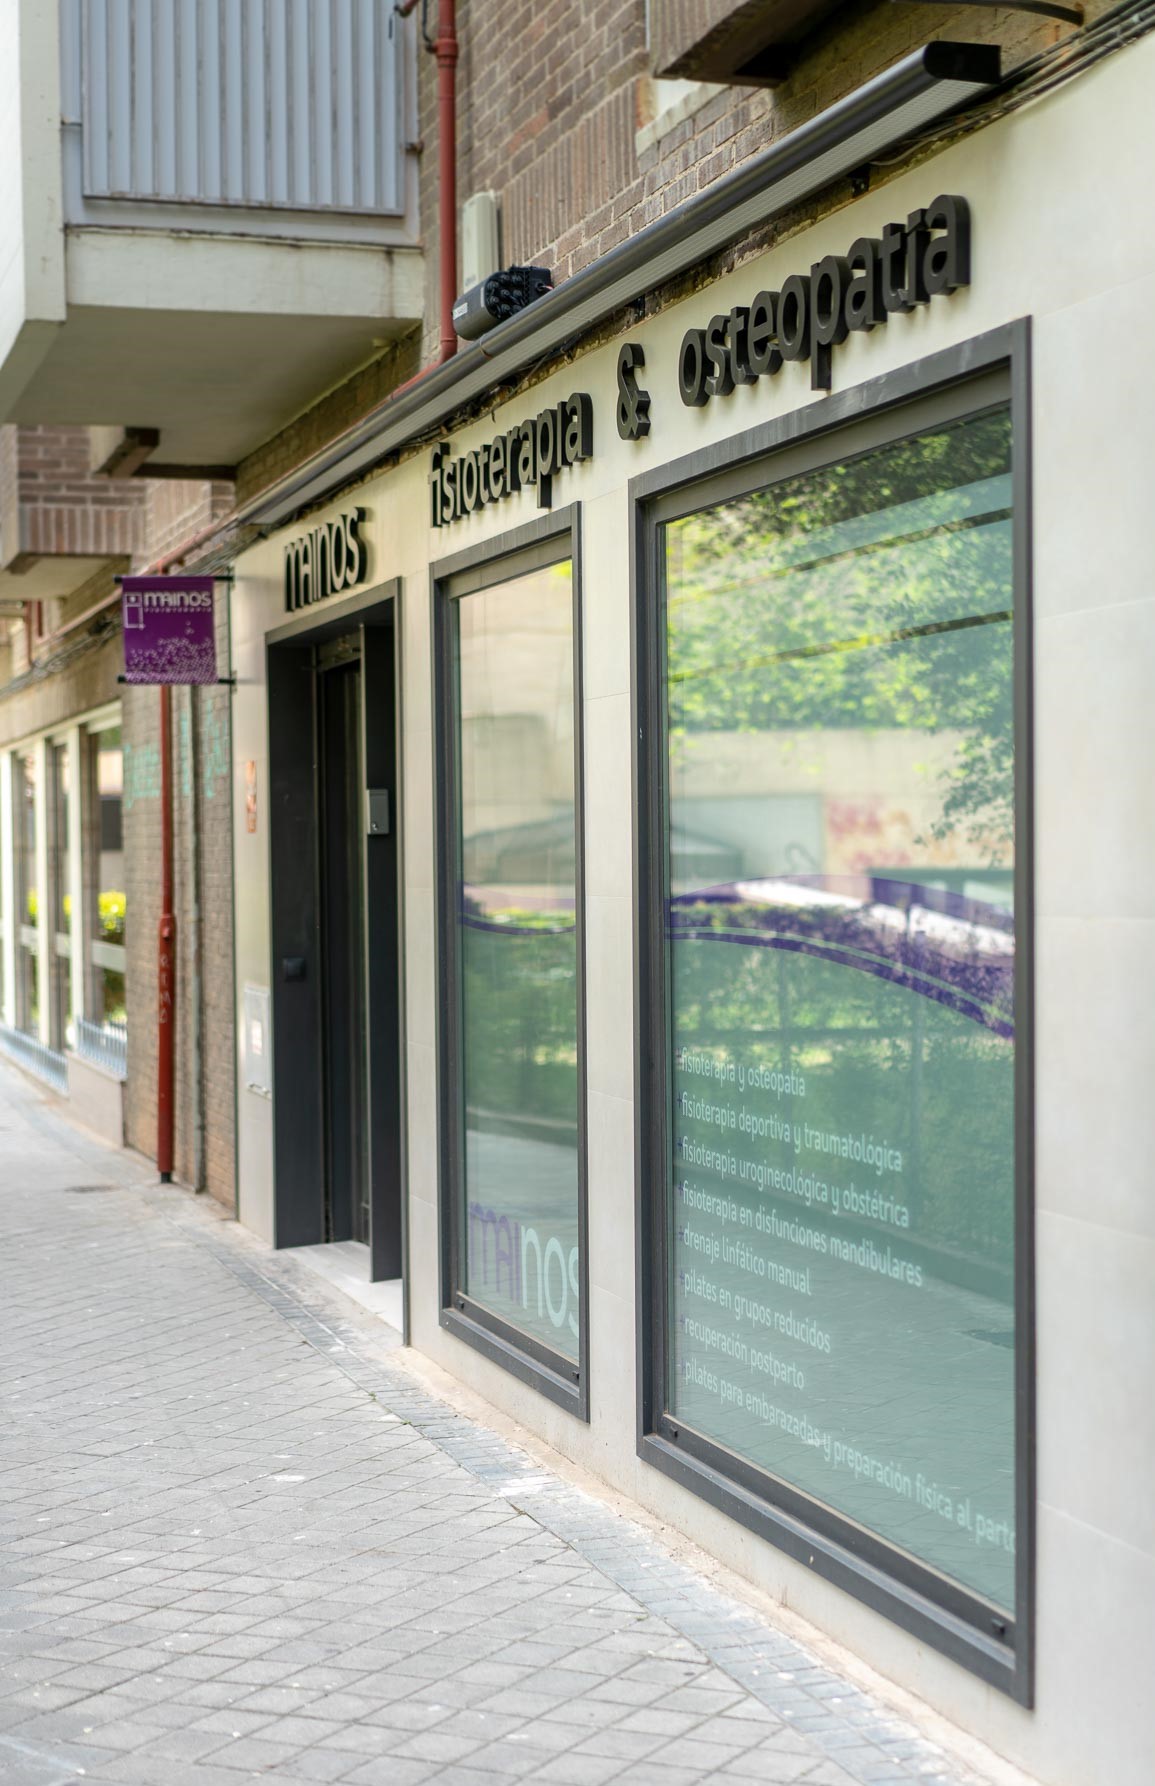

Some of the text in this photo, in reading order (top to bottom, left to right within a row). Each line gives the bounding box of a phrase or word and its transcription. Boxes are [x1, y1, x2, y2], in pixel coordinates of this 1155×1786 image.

[429, 392, 594, 529] fisioterapia
[616, 342, 652, 442] &
[681, 1047, 736, 1088] fisioterapia
[738, 1064, 745, 1092] y
[681, 1091, 903, 1176] fisioterapia deportiva y traumatológica
[682, 1135, 910, 1228] fisioterapia uroginecológica y obstétrica
[682, 1179, 923, 1287] fisioterapia en disfunciones mandibulares
[683, 1221, 812, 1296] drenaje linfático manual
[684, 1269, 831, 1354] pilates en grupos reducidos
[684, 1317, 805, 1390] recuperación postparto
[684, 1356, 718, 1393] pilates
[720, 1378, 743, 1407] para
[745, 1391, 820, 1448] embarazadas
[823, 1432, 831, 1462] y
[957, 1498, 973, 1531] al
